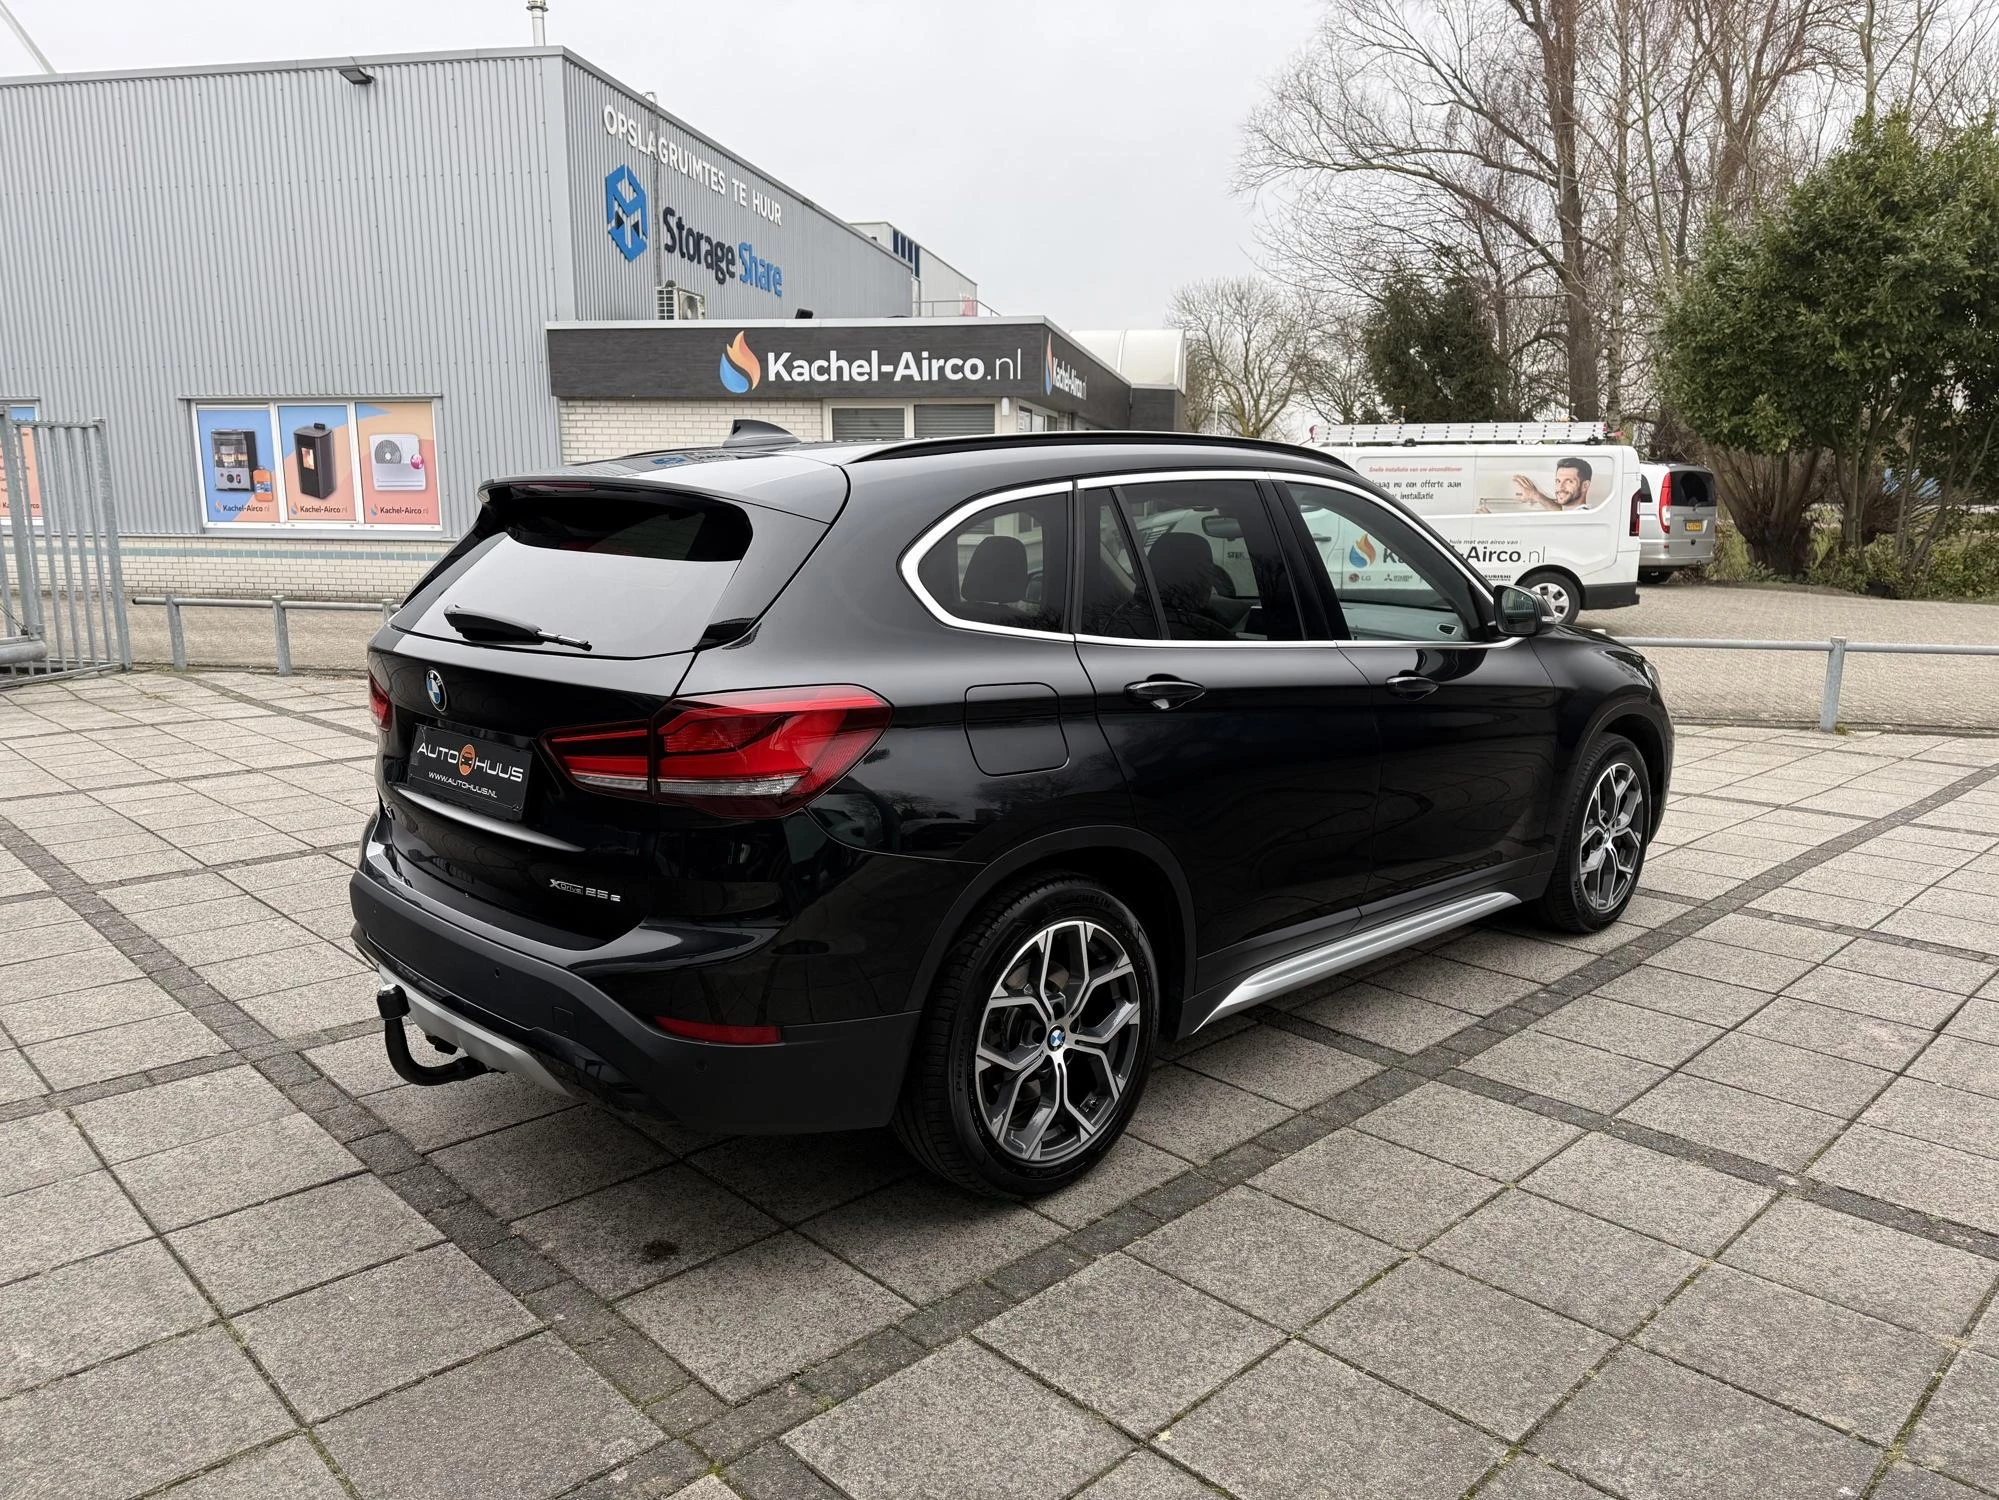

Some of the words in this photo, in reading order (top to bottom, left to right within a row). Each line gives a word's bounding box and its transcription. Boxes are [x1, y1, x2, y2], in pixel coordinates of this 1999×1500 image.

[603, 104, 726, 196] OPSLAGRUIMTES
[731, 177, 747, 207] TE
[752, 188, 782, 226] HUUR
[662, 206, 736, 285] Storage
[738, 241, 783, 297] Share
[767, 347, 1022, 382] Kachel-Airco.nl
[1400, 492, 1434, 500] installatie
[1420, 479, 1444, 488] offerte
[416, 742, 459, 764] AUTO
[474, 756, 524, 782] HUUS
[428, 770, 498, 798] WWW.AUTOHUUS.NL
